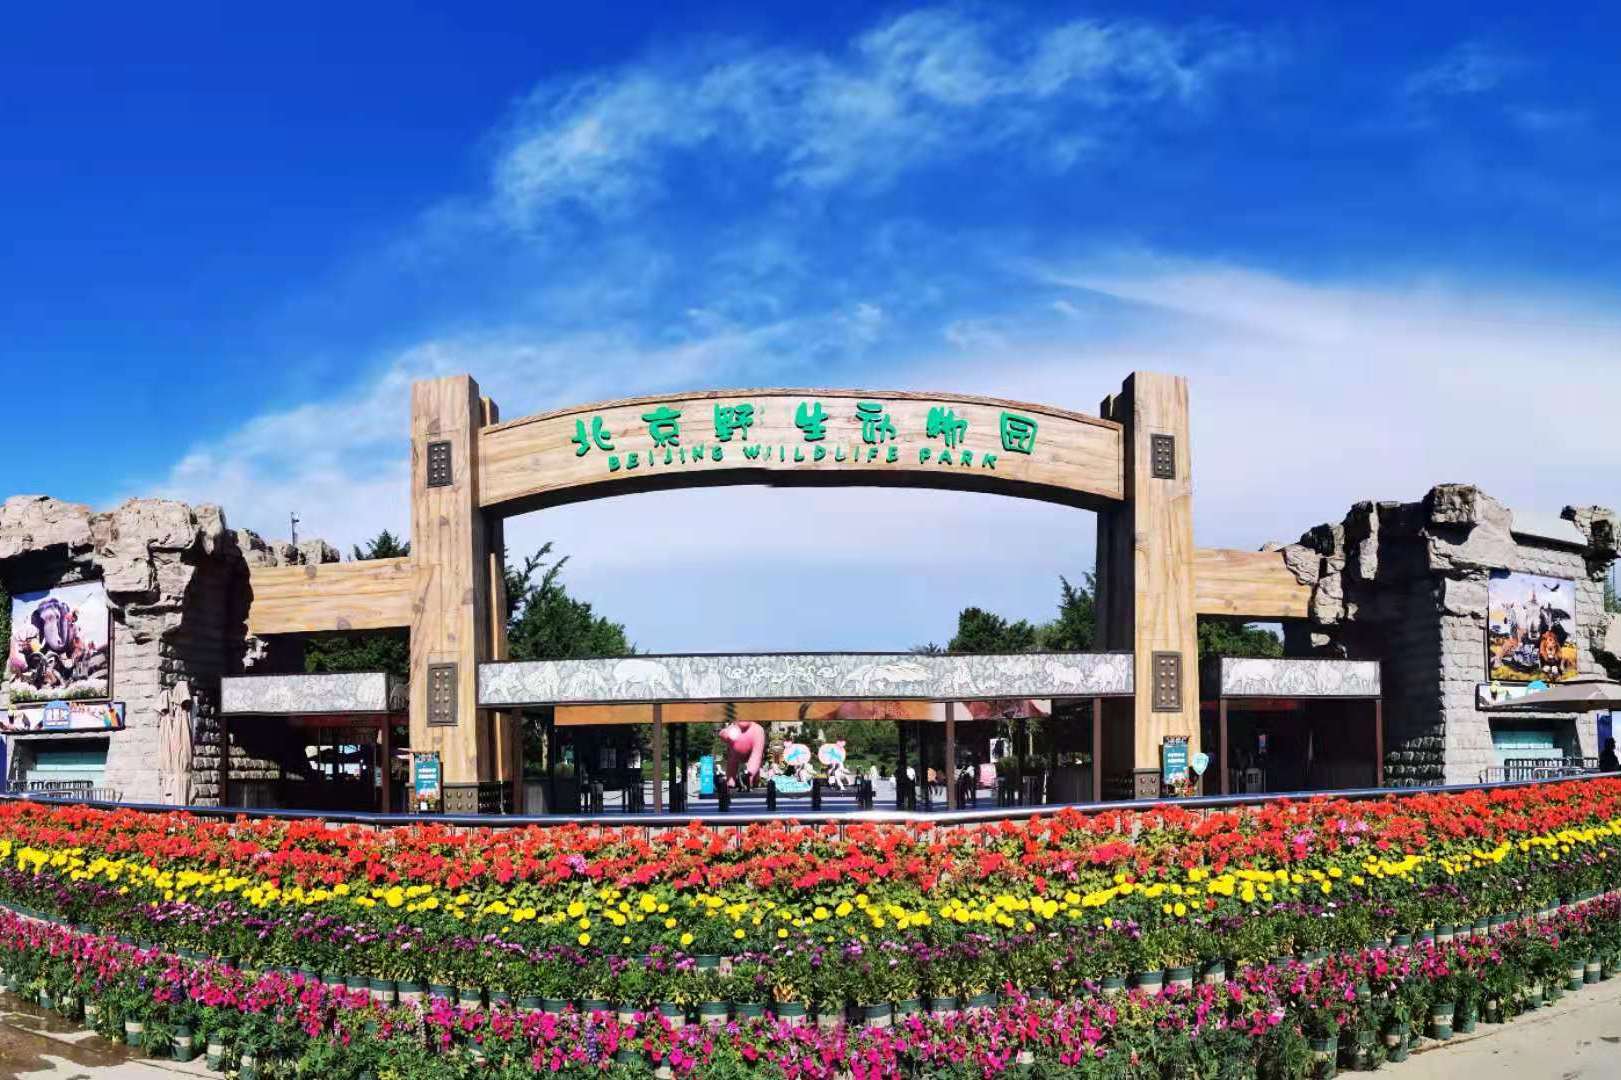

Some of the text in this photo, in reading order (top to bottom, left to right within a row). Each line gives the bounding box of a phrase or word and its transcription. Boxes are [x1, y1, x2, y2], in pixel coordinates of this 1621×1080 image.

[571, 401, 1038, 457] 北京野生动物园
[608, 445, 724, 473] BEIJING
[919, 447, 998, 469] PARK
